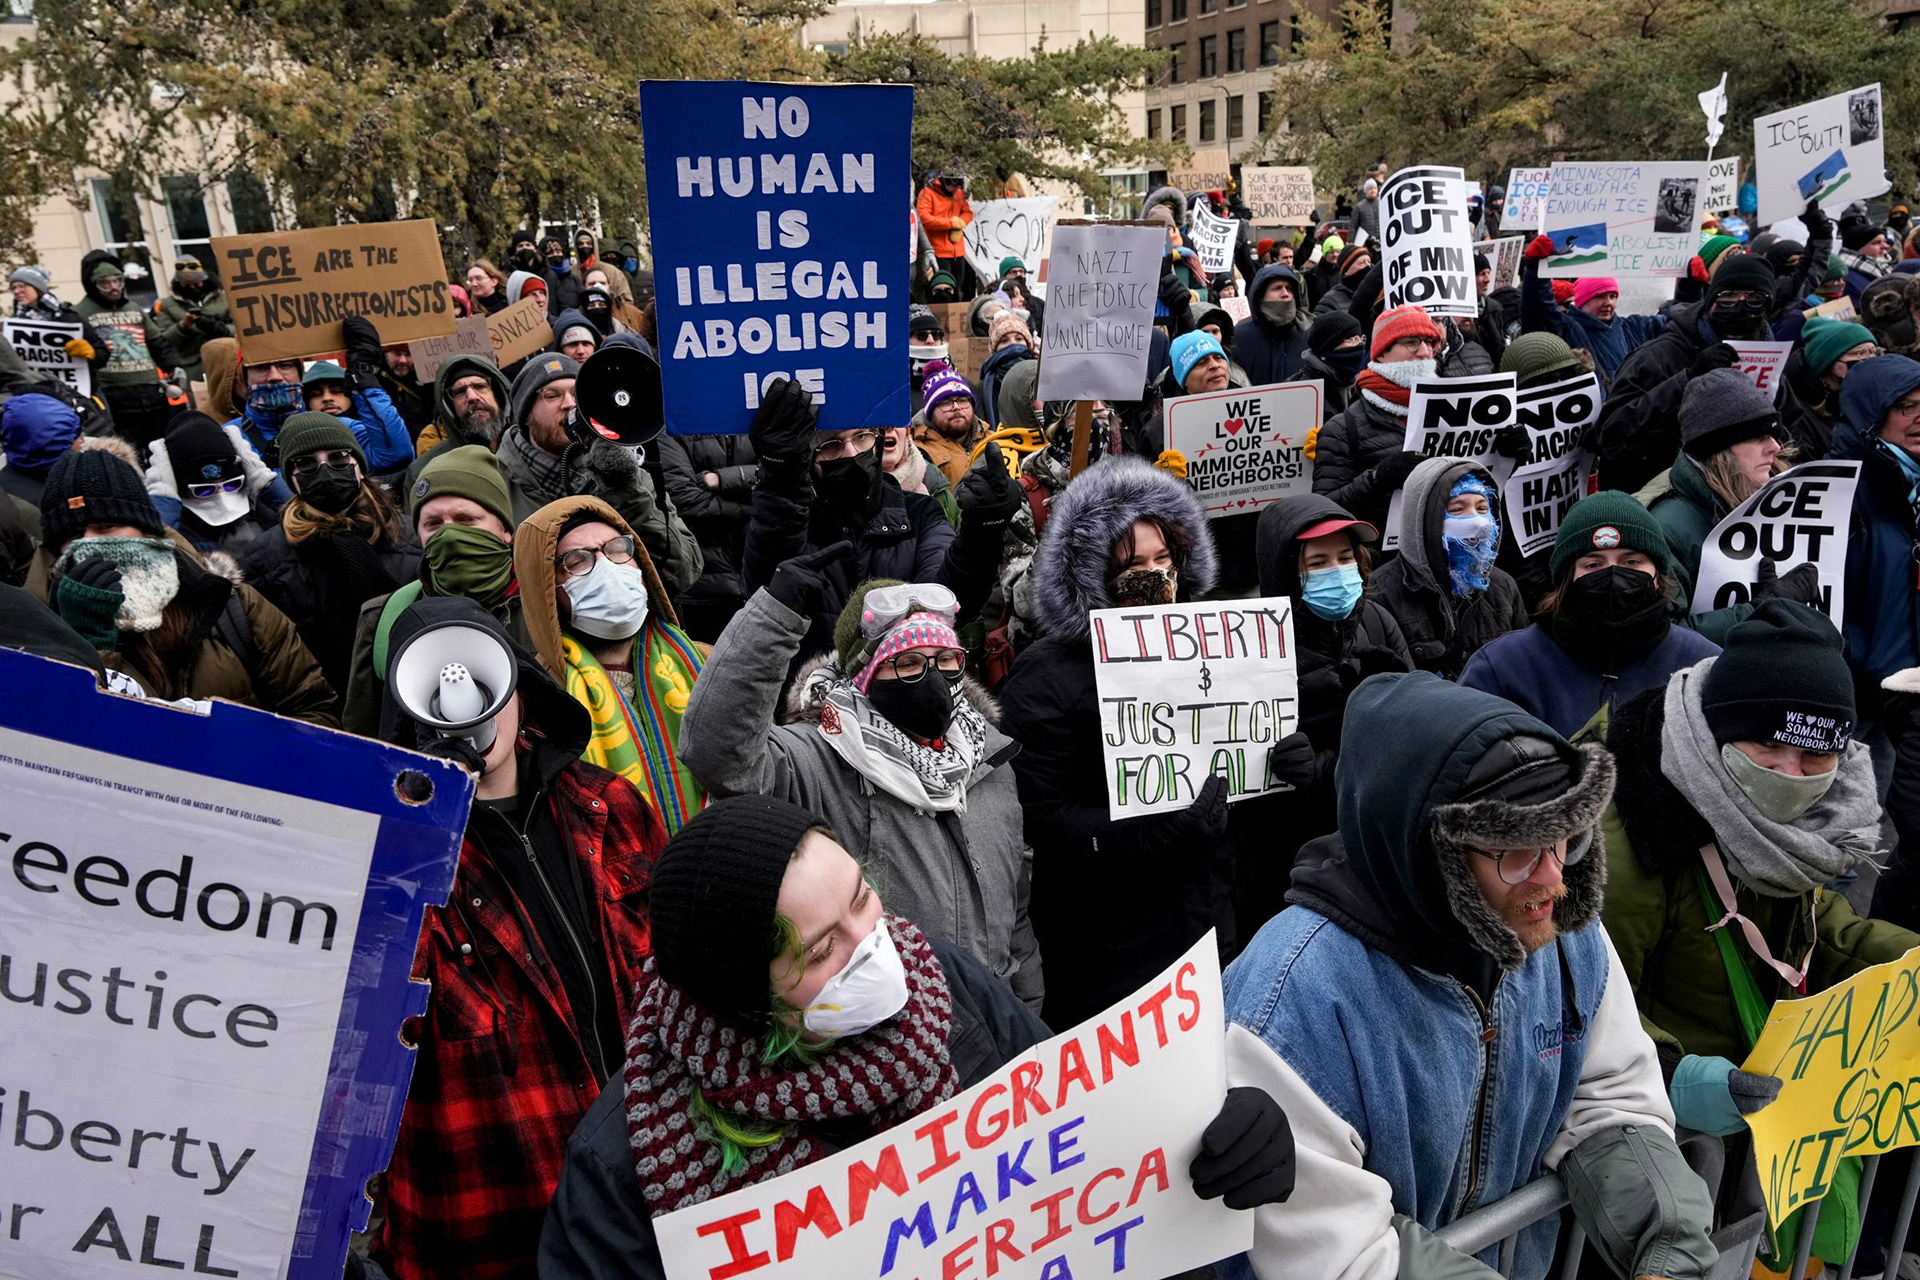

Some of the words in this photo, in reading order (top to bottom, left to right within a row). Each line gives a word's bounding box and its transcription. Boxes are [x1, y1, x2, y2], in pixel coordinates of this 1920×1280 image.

[741, 95, 811, 140] NO
[1766, 114, 1810, 149] ICE
[1800, 124, 1843, 155] OUT!
[675, 152, 876, 198] HUMAN
[1170, 171, 1229, 192] NEIGHBOR
[1247, 172, 1269, 184] SOME
[1270, 174, 1280, 184] OF
[1281, 173, 1307, 183] THOSE
[1551, 166, 1642, 182] MINNESOTA
[1707, 162, 1735, 181] OVE
[1247, 184, 1267, 193] THAT
[1267, 184, 1285, 193] WORK
[1285, 183, 1311, 194] FORCES
[1249, 193, 1264, 202] ARE
[1280, 192, 1296, 202] SAME
[1386, 180, 1449, 219] ICE
[1510, 182, 1550, 198] ICE
[1549, 180, 1608, 196] ALREADY
[1609, 181, 1638, 195] HAS
[1703, 195, 1732, 210] HATE
[1197, 209, 1232, 235] NO
[1250, 202, 1280, 220] BURN
[1280, 202, 1314, 218] CROSSES
[1546, 198, 1609, 215] ENOUGH
[1614, 198, 1649, 213] ICE
[756, 208, 811, 251] IS
[1193, 221, 1229, 244] RACIST
[1385, 208, 1460, 248] OUT
[1610, 235, 1690, 252] ABOLISH
[226, 245, 297, 284] ICE
[313, 248, 355, 273] ARE
[360, 244, 398, 267] THE
[1077, 250, 1133, 275] NAZI
[1201, 255, 1225, 268] MN
[1388, 249, 1413, 287] OF
[1419, 246, 1465, 273] MN
[1611, 254, 1644, 271] ICE
[1650, 254, 1689, 271] NOW
[674, 259, 889, 307] ILLEGAL
[1053, 281, 1149, 310] RHETORIC
[1388, 274, 1469, 309] NOW
[235, 279, 448, 338] INSURRECTIONISTS
[13, 329, 76, 347] NO
[422, 336, 455, 358] LEAVE
[456, 330, 483, 351] OUR
[672, 310, 888, 360] ABOLISH
[1046, 320, 1146, 352] UNWELCOME
[1225, 398, 1262, 419] WE
[1422, 393, 1512, 429] NO
[1516, 393, 1594, 432] NO
[1224, 434, 1263, 453] OUR
[1186, 445, 1305, 478] IMMIGRANT
[1186, 462, 1304, 493] NEIGHBORS!
[1522, 461, 1580, 508] HATE
[1742, 481, 1831, 520] ICE
[1522, 504, 1552, 538] IN
[1717, 521, 1835, 563] OUT
[1094, 606, 1291, 664] LIBERTY
[1102, 697, 1296, 747] JUSTICE
[1785, 721, 1827, 740] SOMALI
[1786, 710, 1805, 724] WE
[1816, 716, 1836, 730] OUR
[1773, 729, 1830, 751] NEIGHBORS
[1115, 753, 1196, 806] FOR
[1209, 747, 1289, 797] ALL
[24, 760, 61, 776] MAINTAIN
[62, 769, 103, 787] FRESHNESS
[103, 780, 112, 789] IN
[113, 782, 144, 796] TRANSIT
[144, 789, 164, 801] WITH
[165, 794, 180, 804] ONE
[181, 797, 192, 806] OR
[193, 800, 214, 812] MORE
[215, 805, 224, 814] OF
[225, 807, 239, 818] THE
[240, 810, 284, 828] FOLLOWING:
[0, 831, 339, 951] eedom
[696, 961, 1202, 1280] IMMIGRANTS
[879, 1115, 1086, 1279] MAKE
[912, 1147, 1170, 1280] ERICA
[71, 1206, 240, 1279] ALL
